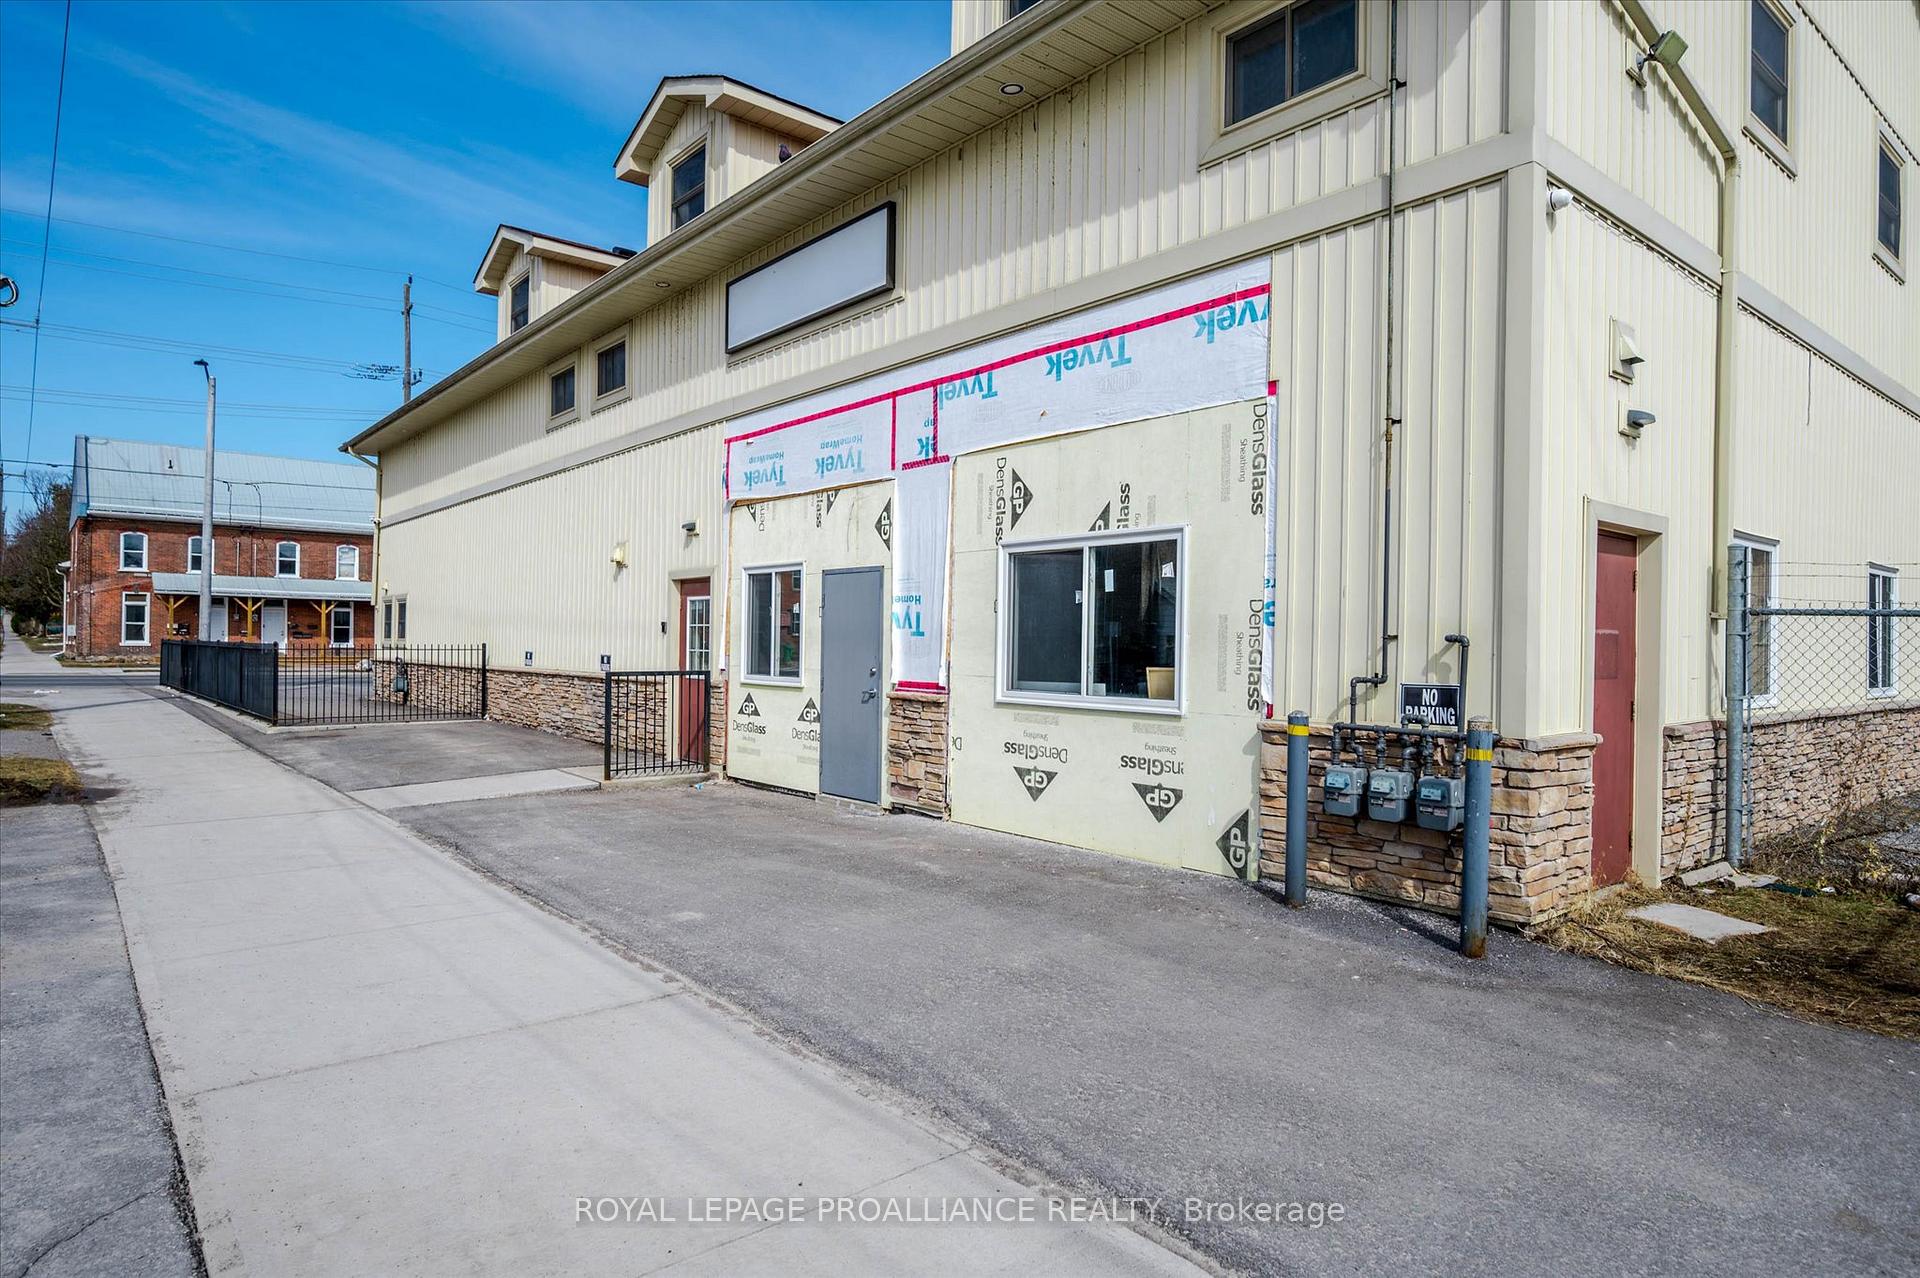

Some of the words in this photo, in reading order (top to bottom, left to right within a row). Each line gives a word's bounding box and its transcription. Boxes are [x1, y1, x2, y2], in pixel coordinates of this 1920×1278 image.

[1045, 335, 1132, 382] Tyvek
[815, 446, 865, 479] Tyvek
[1251, 403, 1267, 516] DensGlass
[744, 461, 787, 491] Tyvek
[1012, 481, 1024, 515] GP
[881, 511, 890, 540] GP
[1247, 599, 1264, 711] DensGlass
[742, 702, 755, 714] GP
[1422, 688, 1438, 706] NO
[803, 708, 818, 721] GP
[1405, 705, 1456, 725] PARKING
[732, 720, 766, 735] DensGlass
[1003, 741, 1068, 764] DensGlass
[1120, 755, 1184, 776] nsGlass
[1024, 771, 1048, 789] GP
[1145, 788, 1176, 808] GP
[1230, 827, 1247, 869] GP
